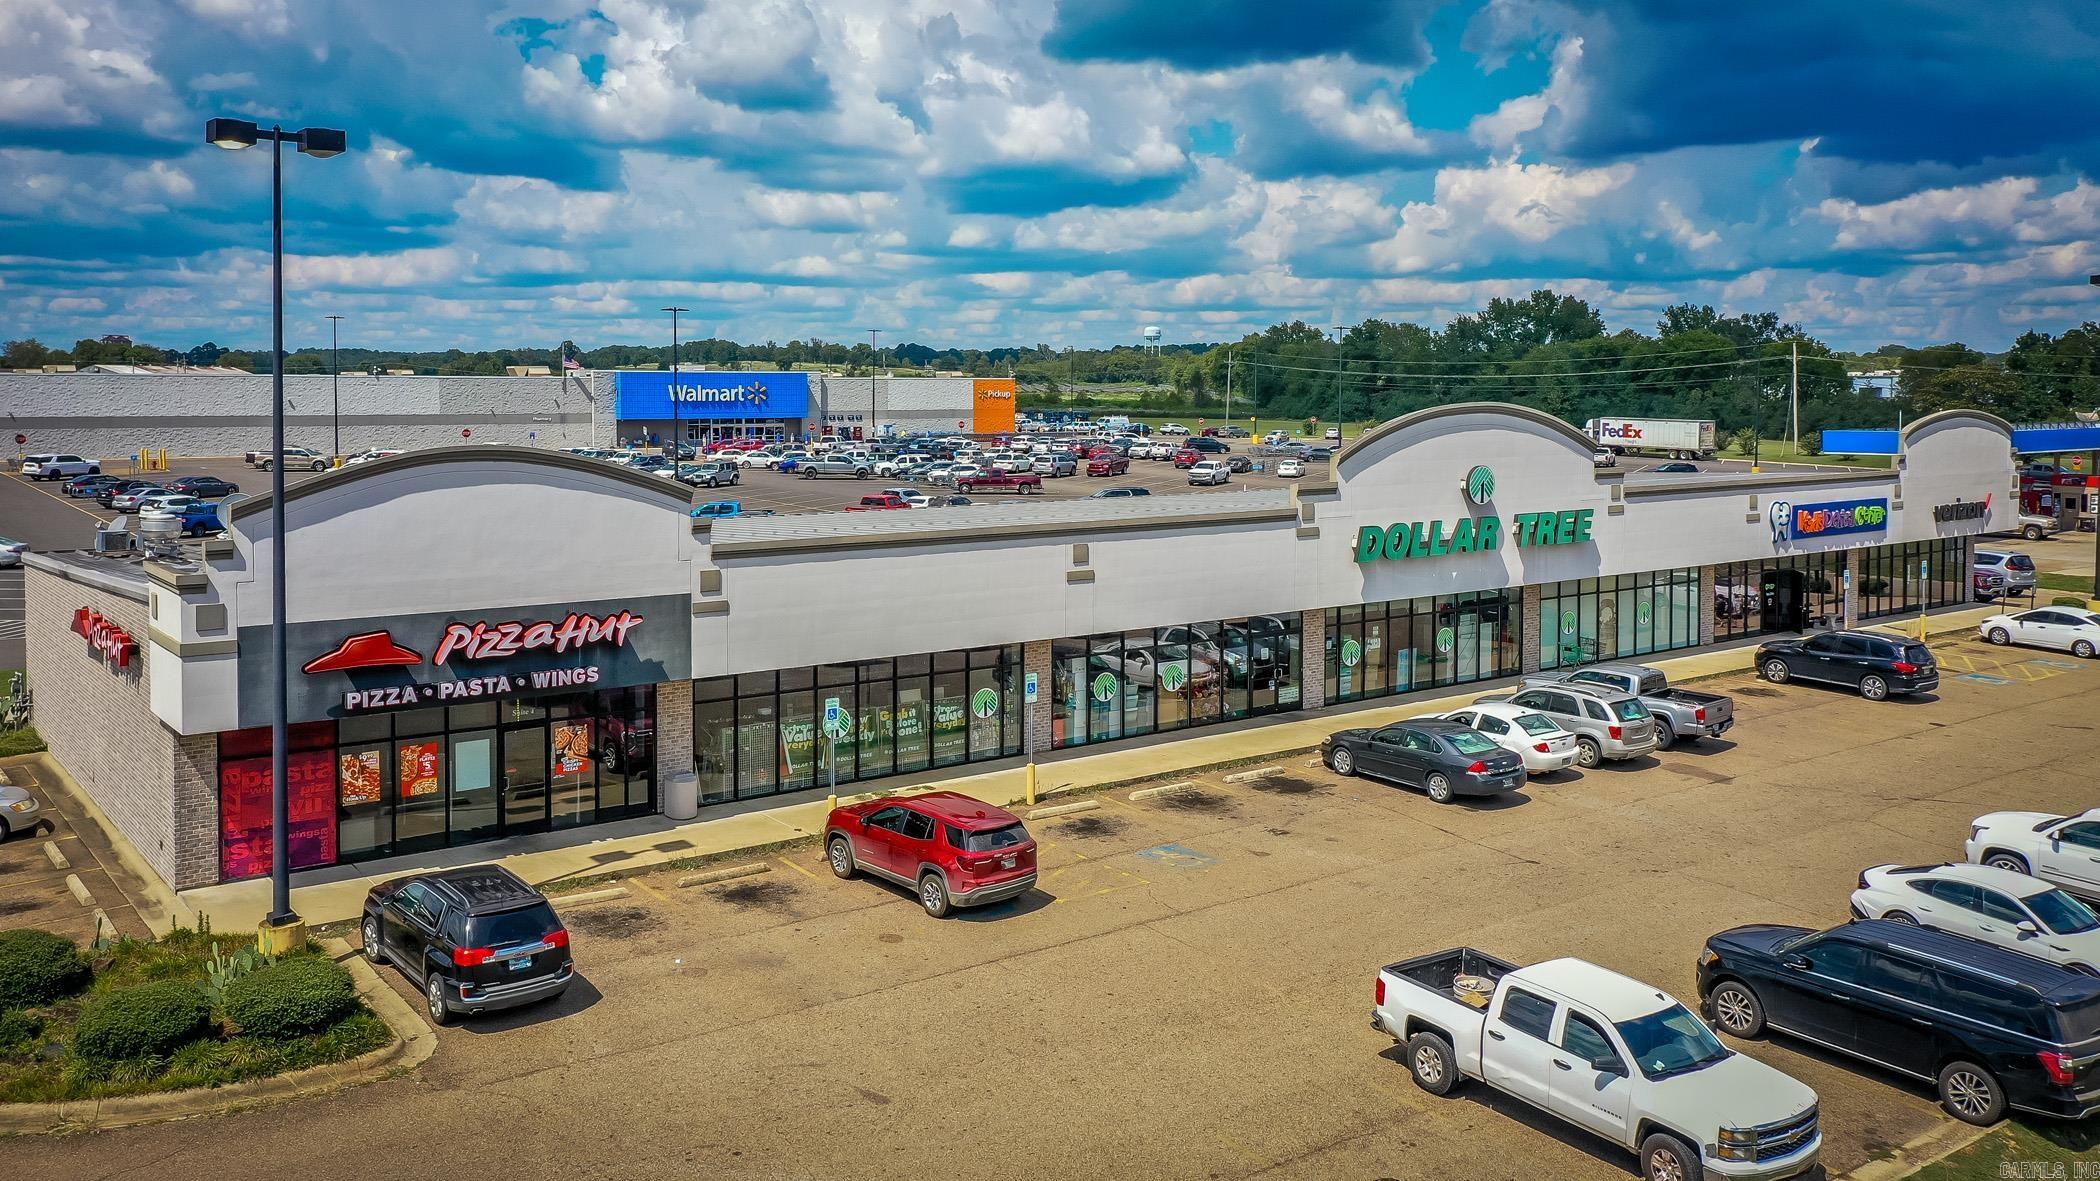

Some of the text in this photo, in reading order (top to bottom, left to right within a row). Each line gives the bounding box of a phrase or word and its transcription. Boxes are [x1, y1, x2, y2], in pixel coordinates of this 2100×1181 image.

[668, 384, 745, 402] Walmart
[988, 389, 1011, 399] Pickup
[1602, 422, 1643, 439] FedEx
[1932, 498, 1986, 523] verizon
[1354, 508, 1594, 563] DOLLAR TREE
[433, 610, 644, 666] Pizza Hut
[345, 667, 600, 710] PIZZA PASTA WINGS
[780, 723, 813, 732] Extrem
[886, 718, 917, 728] Bfore
